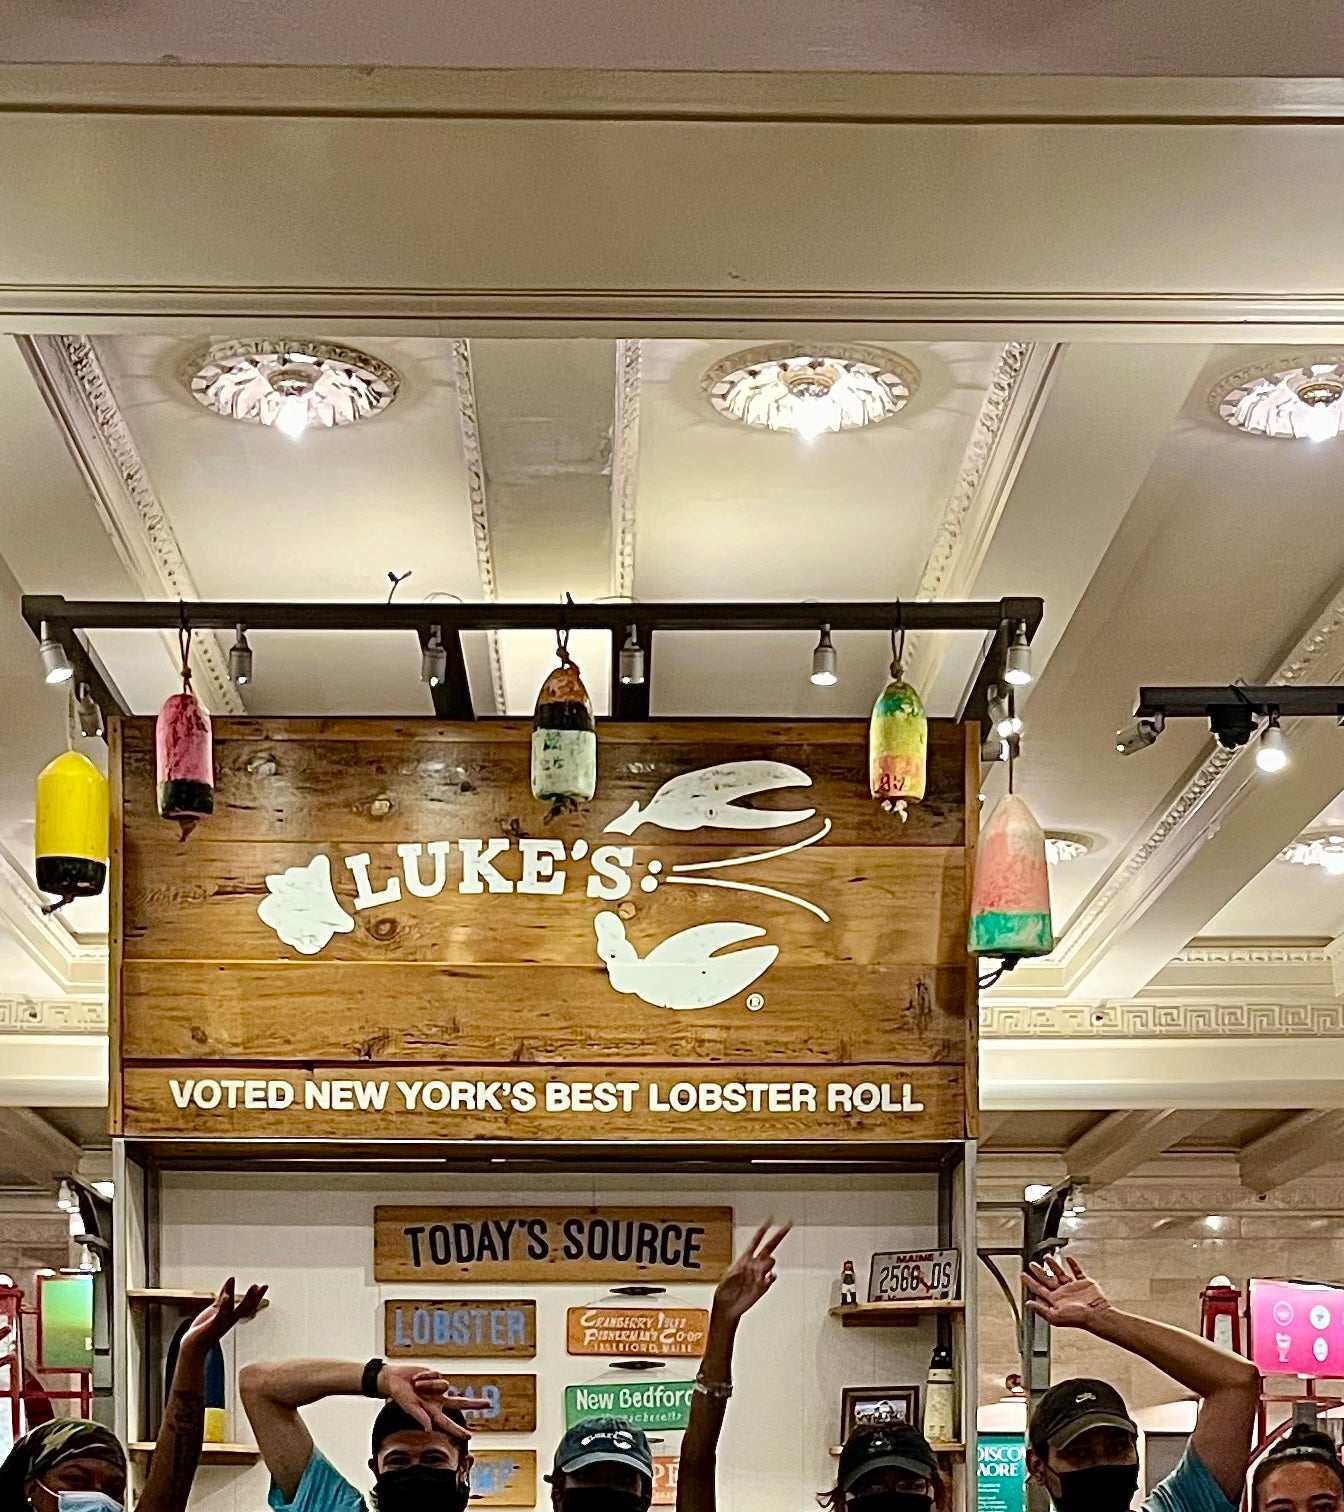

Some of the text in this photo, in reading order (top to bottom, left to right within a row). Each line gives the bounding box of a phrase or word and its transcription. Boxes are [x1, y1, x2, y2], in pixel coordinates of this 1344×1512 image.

[344, 838, 635, 911] LUKE'S
[168, 1079, 925, 1113] VOTED NEW YORK'S BEST LOBSTER ROLL
[403, 1218, 705, 1269] TODAY'S SOURCE
[896, 1253, 934, 1264] MAINE
[394, 1307, 526, 1347] LOBSTER
[575, 1389, 615, 1411] New
